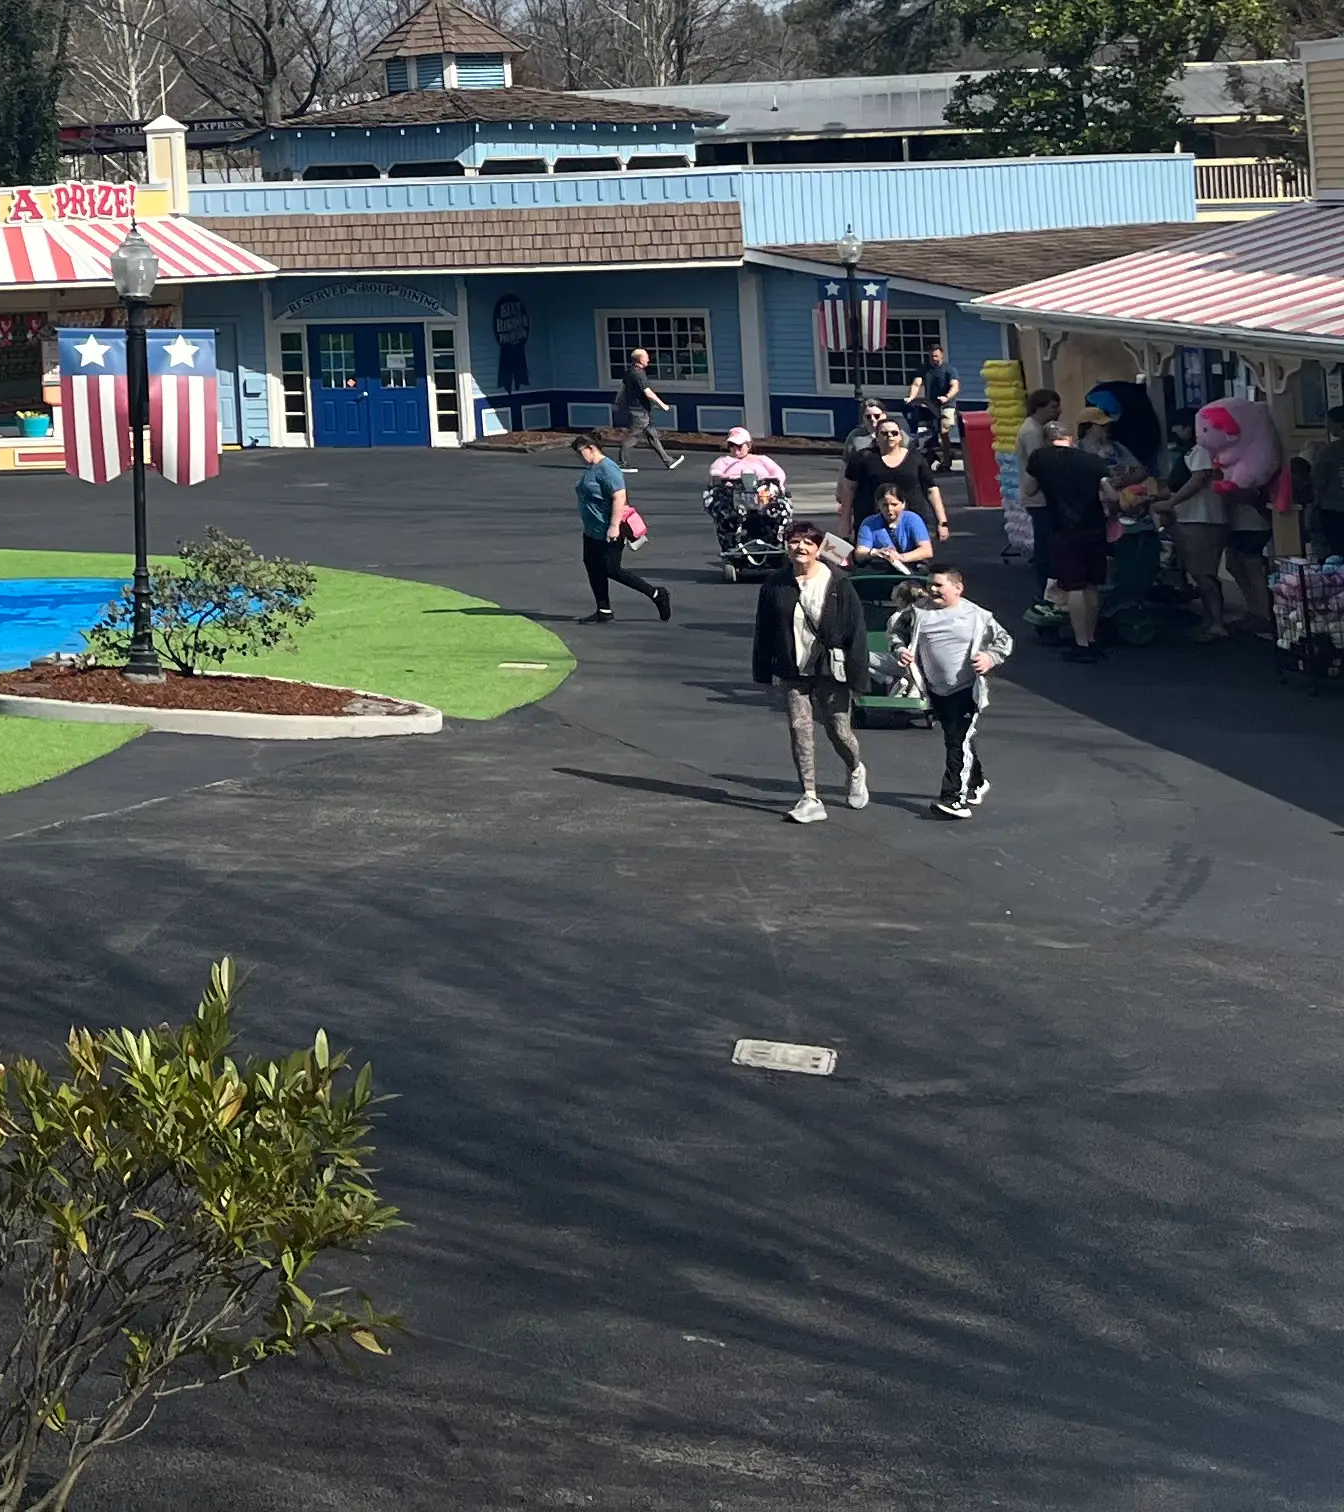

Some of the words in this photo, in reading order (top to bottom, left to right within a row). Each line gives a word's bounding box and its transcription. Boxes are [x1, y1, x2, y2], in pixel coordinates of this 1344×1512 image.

[193, 120, 245, 131] EXPRESS
[10, 190, 44, 220] A
[55, 184, 136, 218] PRIZE!
[288, 284, 348, 314] RESERVED
[353, 282, 393, 295] GROUP
[399, 288, 441, 312] DINING
